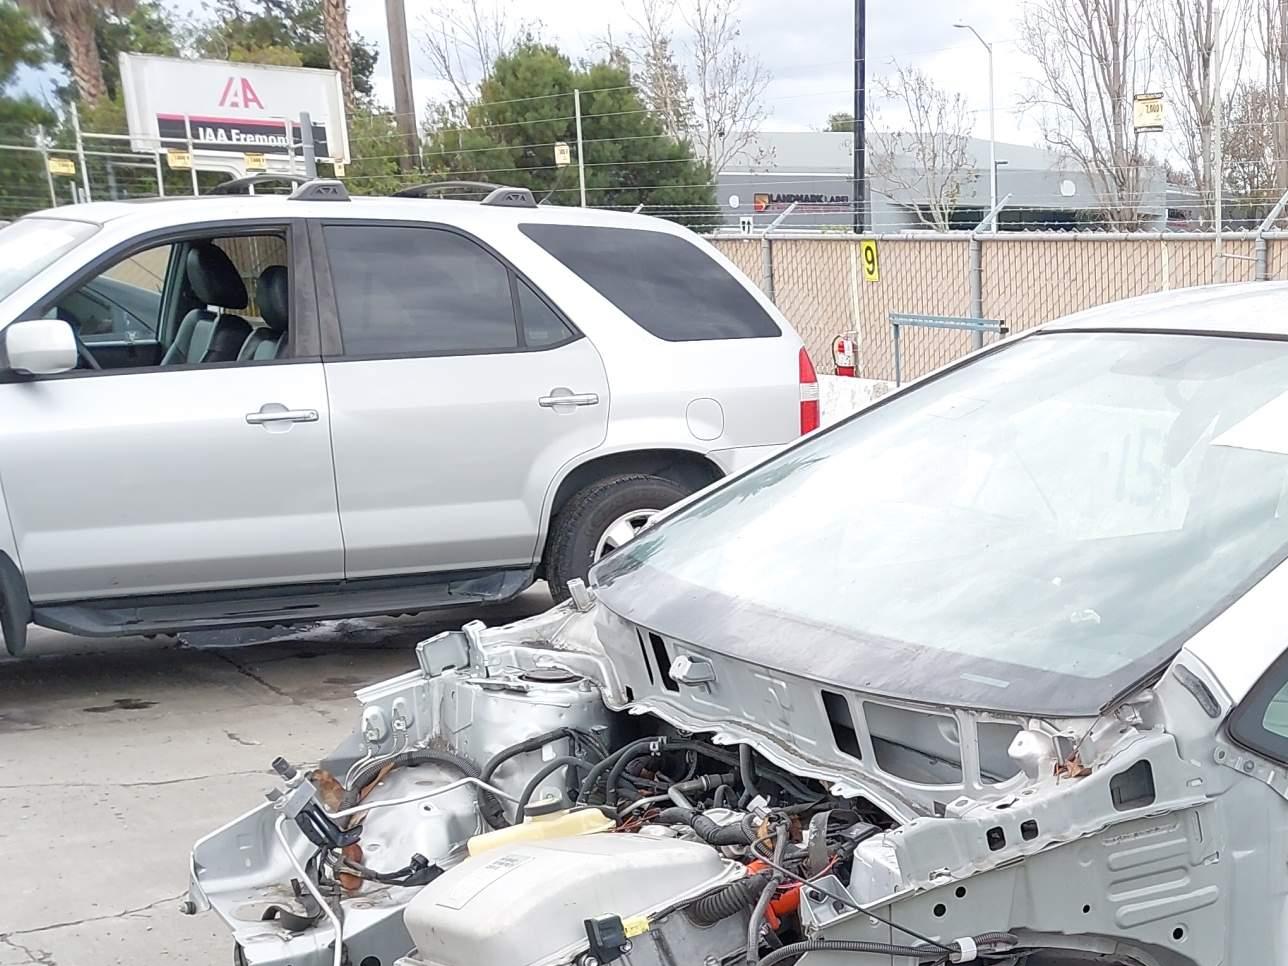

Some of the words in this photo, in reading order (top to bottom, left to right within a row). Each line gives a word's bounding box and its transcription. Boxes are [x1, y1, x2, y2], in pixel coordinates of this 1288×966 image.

[198, 127, 228, 142] IAA
[231, 129, 289, 147] Fremon
[770, 193, 824, 202] LANDMARK
[865, 245, 875, 275] 9
